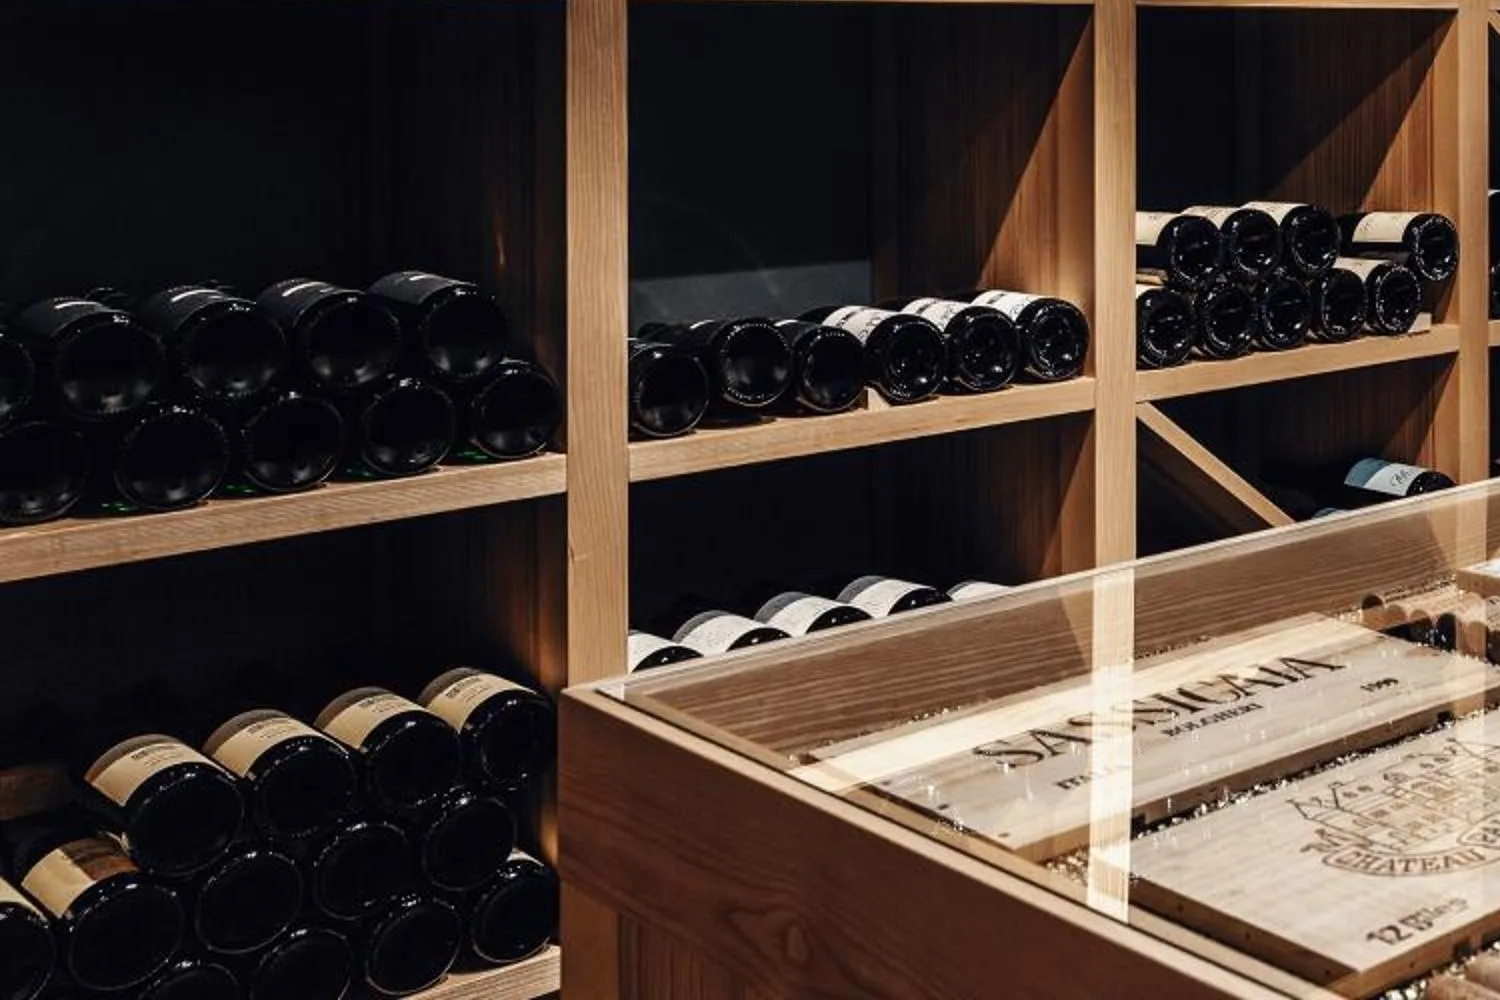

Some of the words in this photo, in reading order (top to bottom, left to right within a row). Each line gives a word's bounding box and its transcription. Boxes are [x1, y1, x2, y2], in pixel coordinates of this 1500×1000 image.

[972, 656, 1347, 768] SASSICAIA
[1335, 848, 1486, 875] CHATEAU
[1365, 922, 1414, 946] 12
